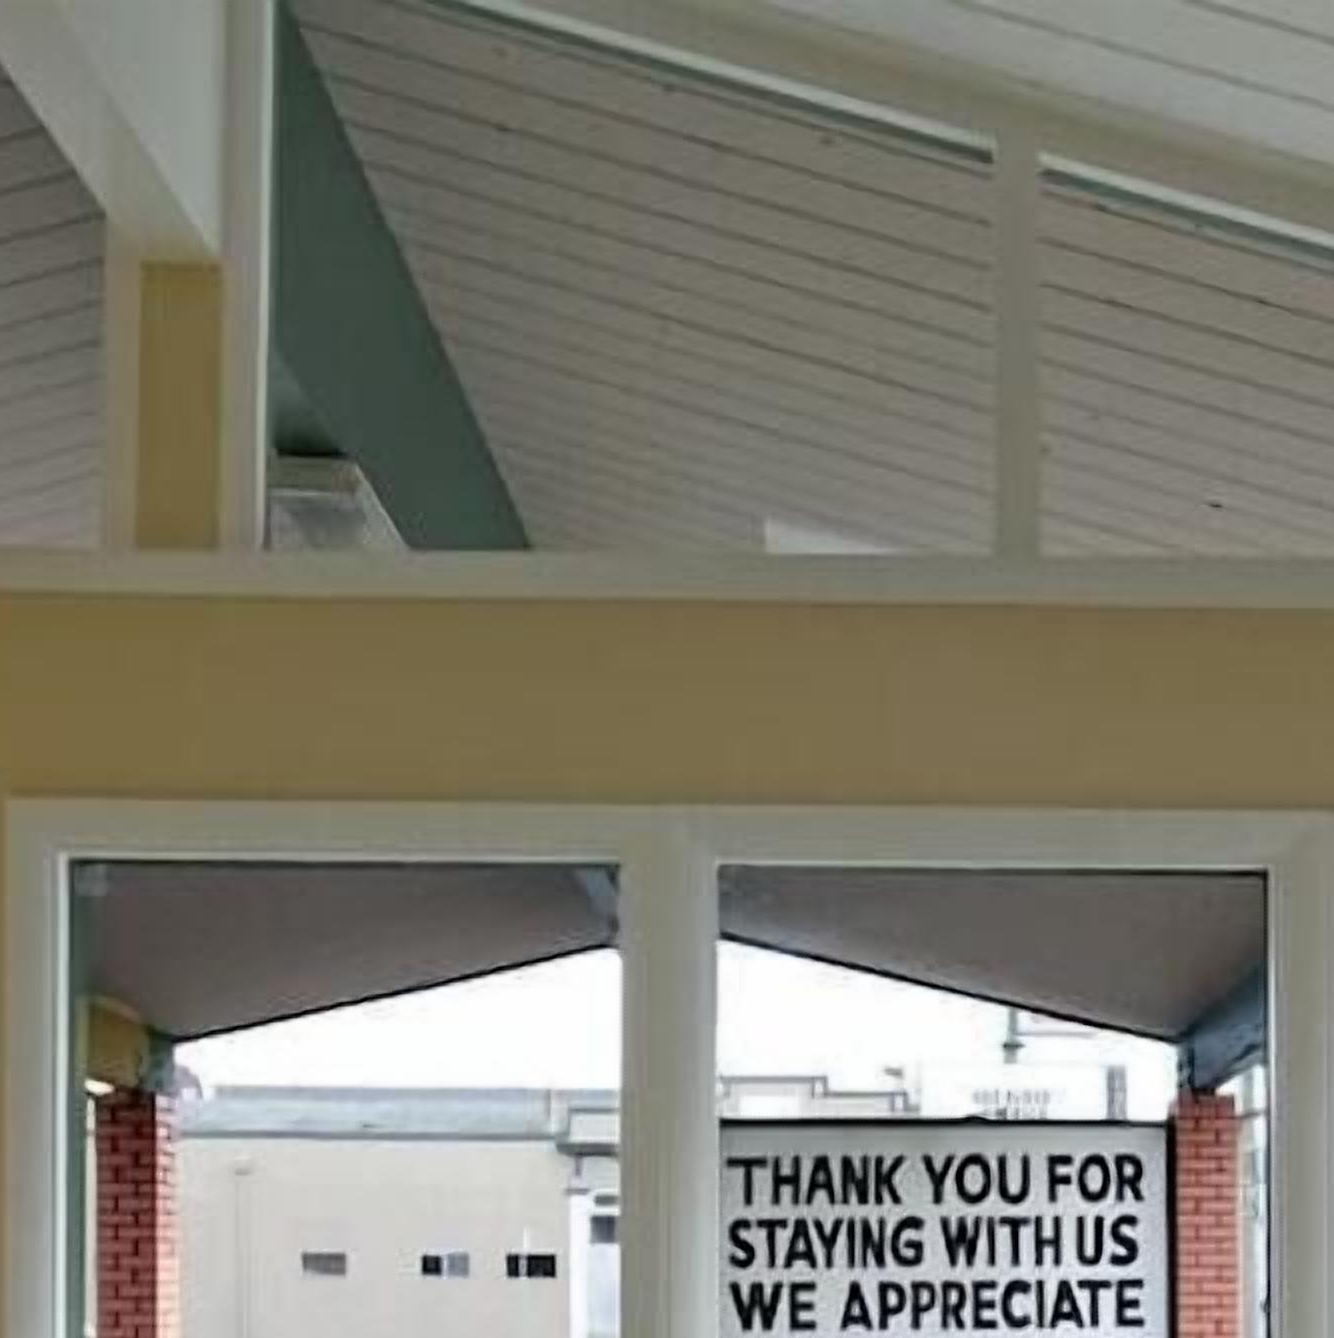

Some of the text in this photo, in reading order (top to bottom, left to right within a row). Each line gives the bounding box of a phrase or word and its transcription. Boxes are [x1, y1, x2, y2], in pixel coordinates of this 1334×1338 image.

[726, 1153, 1144, 1206] THANK YOU FOR
[728, 1214, 1139, 1269] STAYING WITH US
[729, 1279, 1145, 1332] WE APPRECIATE
